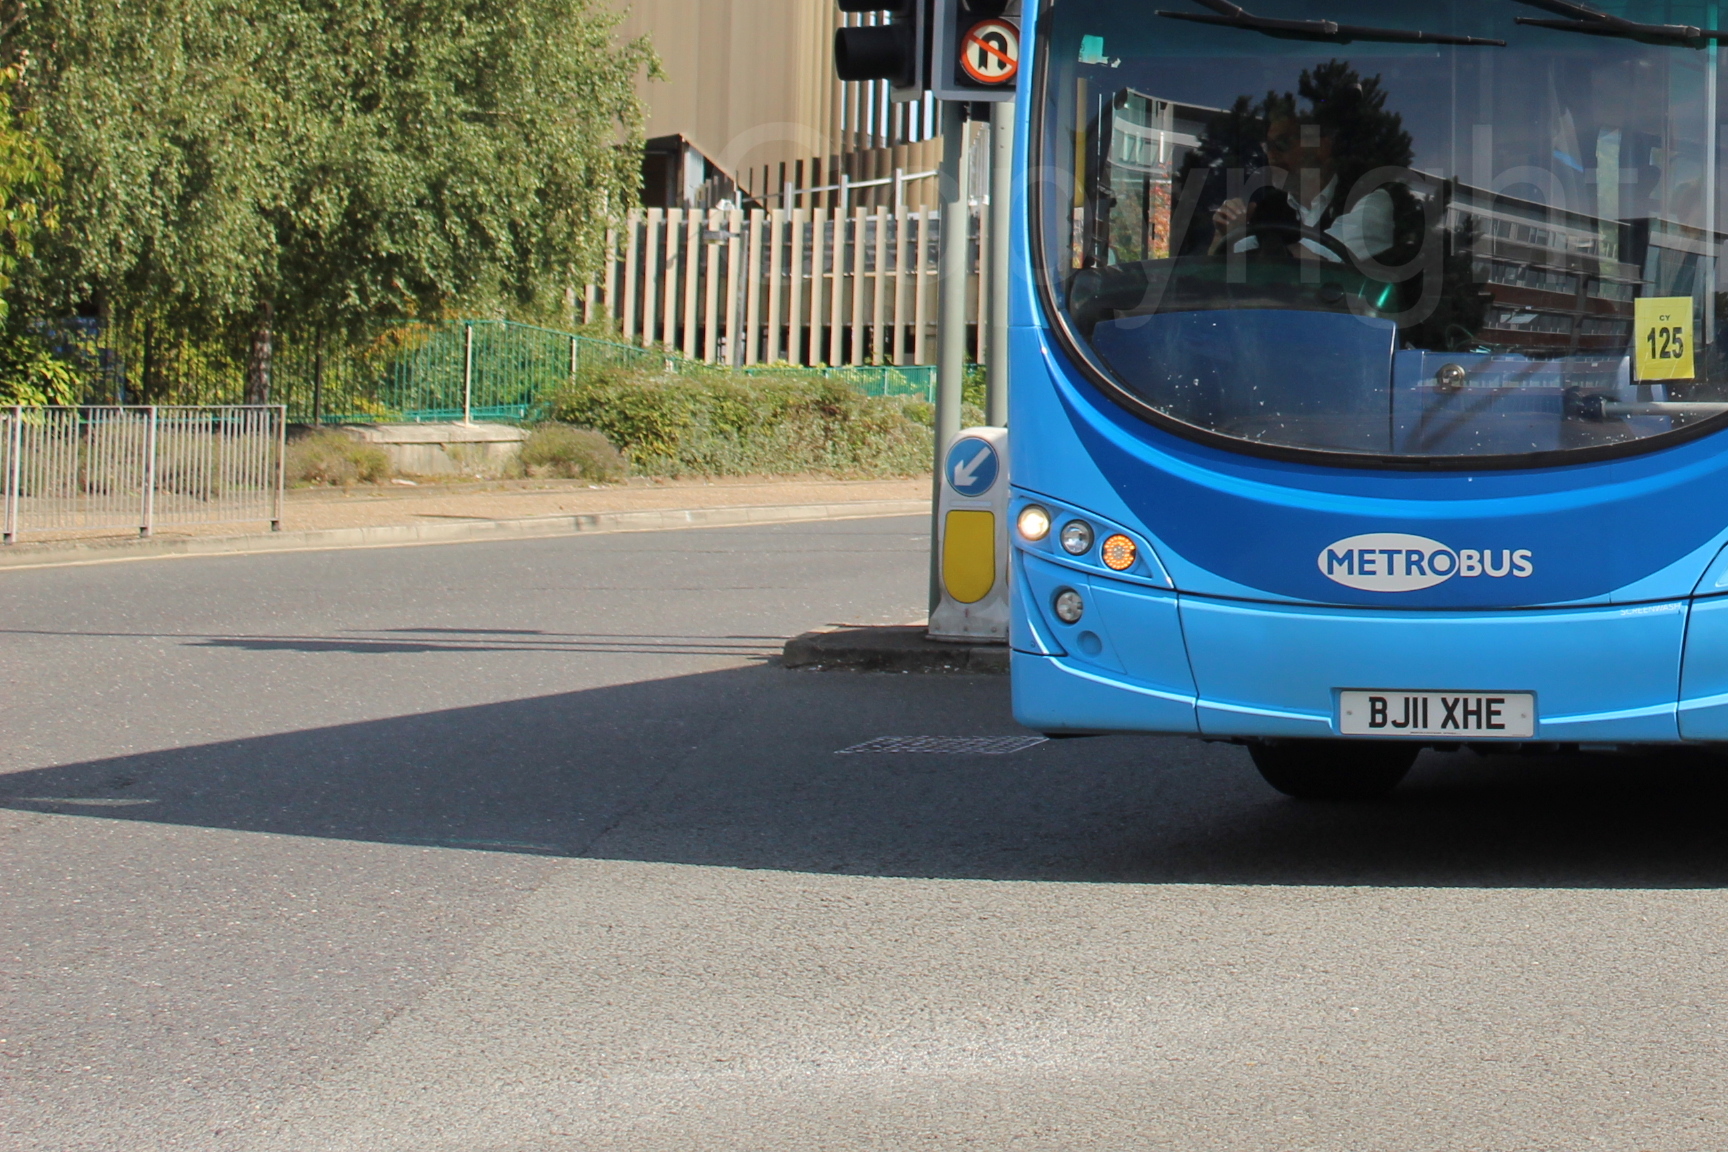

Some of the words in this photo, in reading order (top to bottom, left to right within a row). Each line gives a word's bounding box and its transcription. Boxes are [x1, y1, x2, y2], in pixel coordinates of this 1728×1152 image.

[1658, 314, 1671, 322] CY
[1646, 326, 1684, 359] 125
[1325, 547, 1534, 578] METROBUS
[1620, 601, 1682, 616] SCREENWASH
[1368, 696, 1429, 729] BJ11
[1440, 697, 1506, 730] XHE
